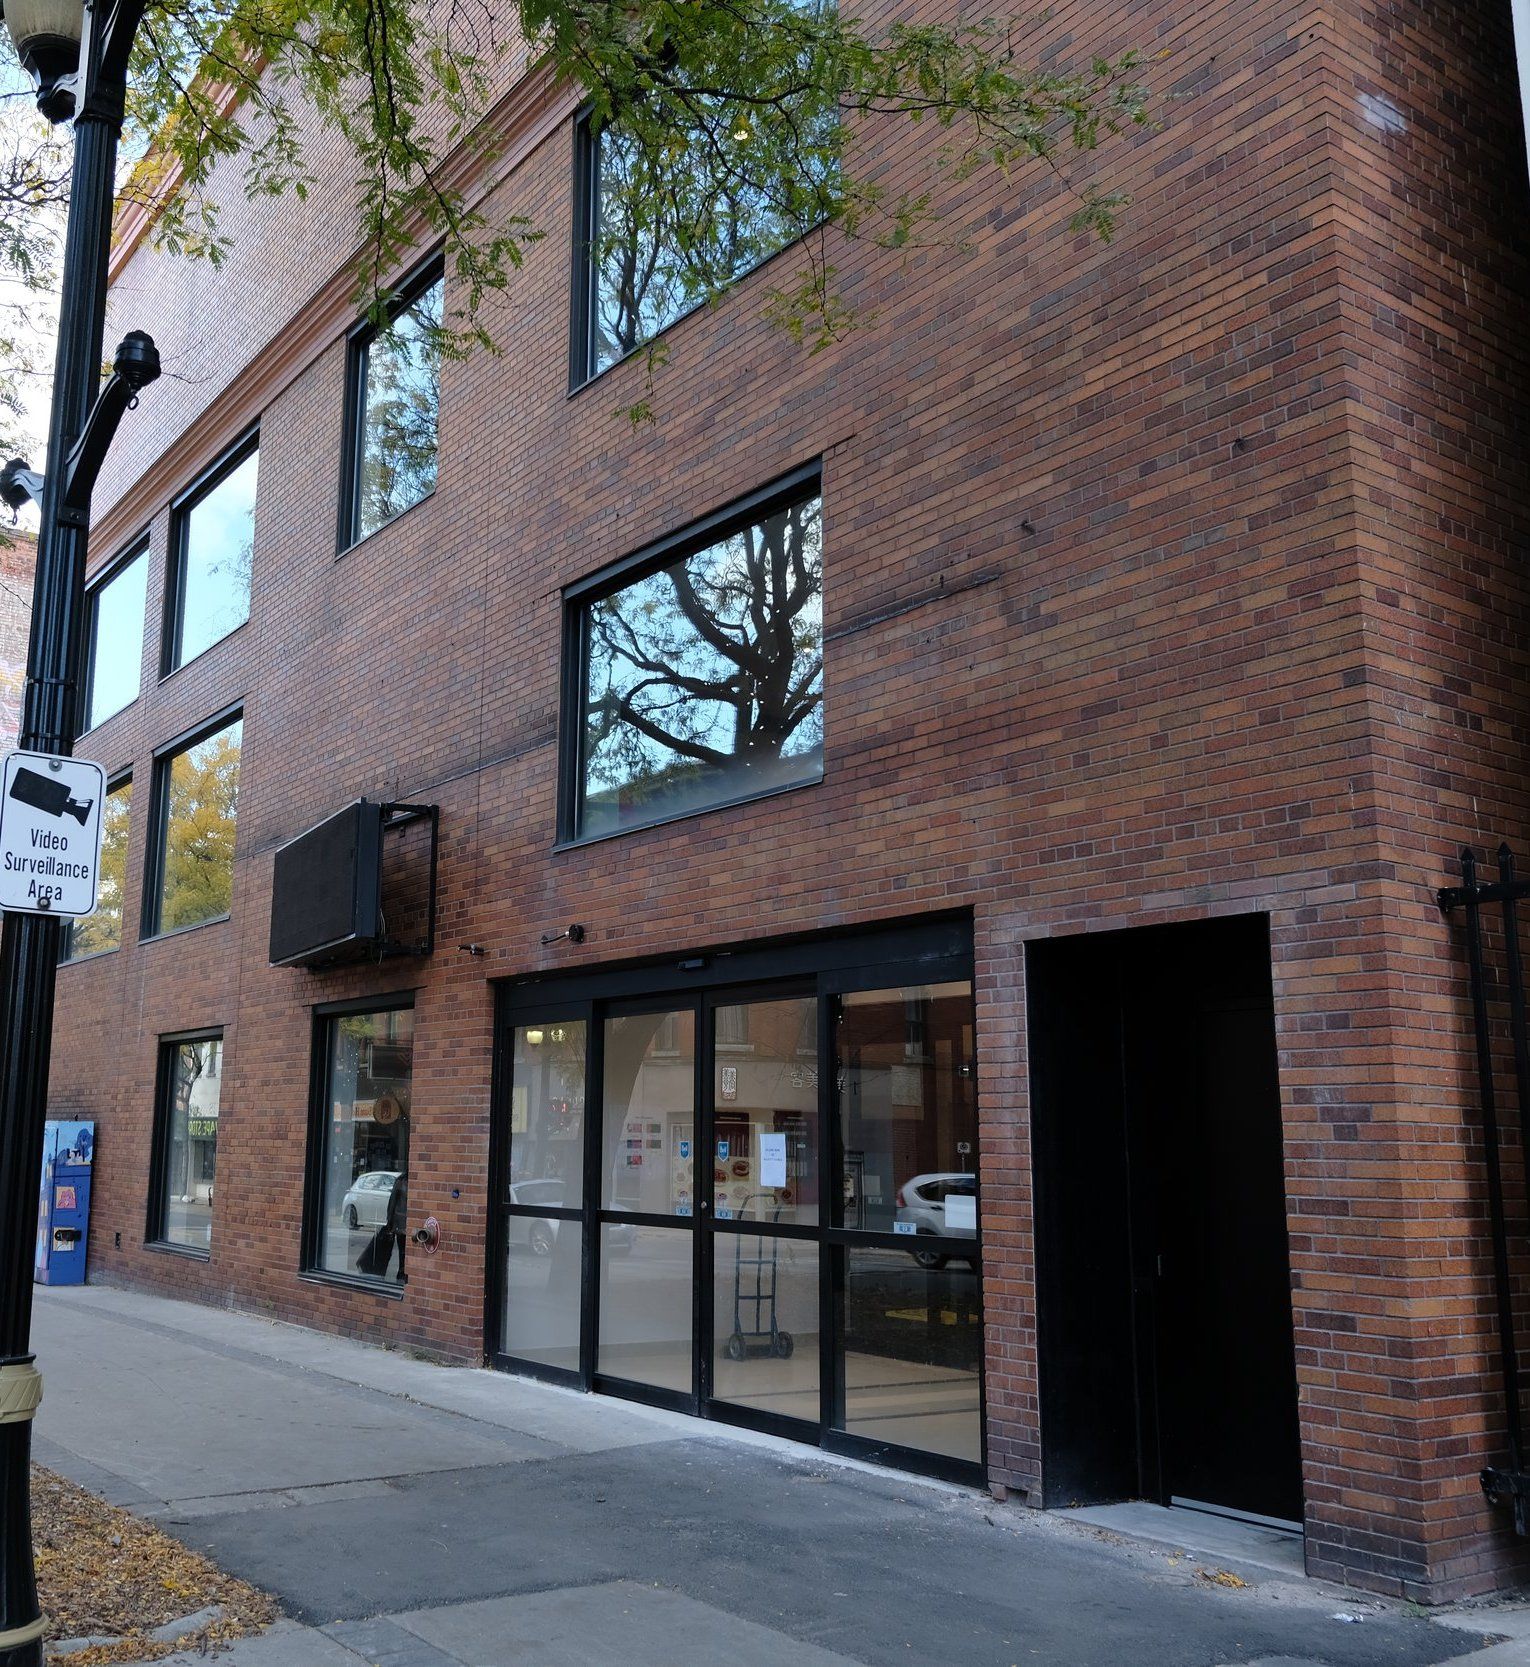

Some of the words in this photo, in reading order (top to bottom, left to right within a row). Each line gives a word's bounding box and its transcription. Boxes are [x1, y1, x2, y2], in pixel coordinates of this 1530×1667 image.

[31, 828, 68, 851] Video
[4, 851, 89, 879] Surveillance
[28, 879, 62, 901] Area
